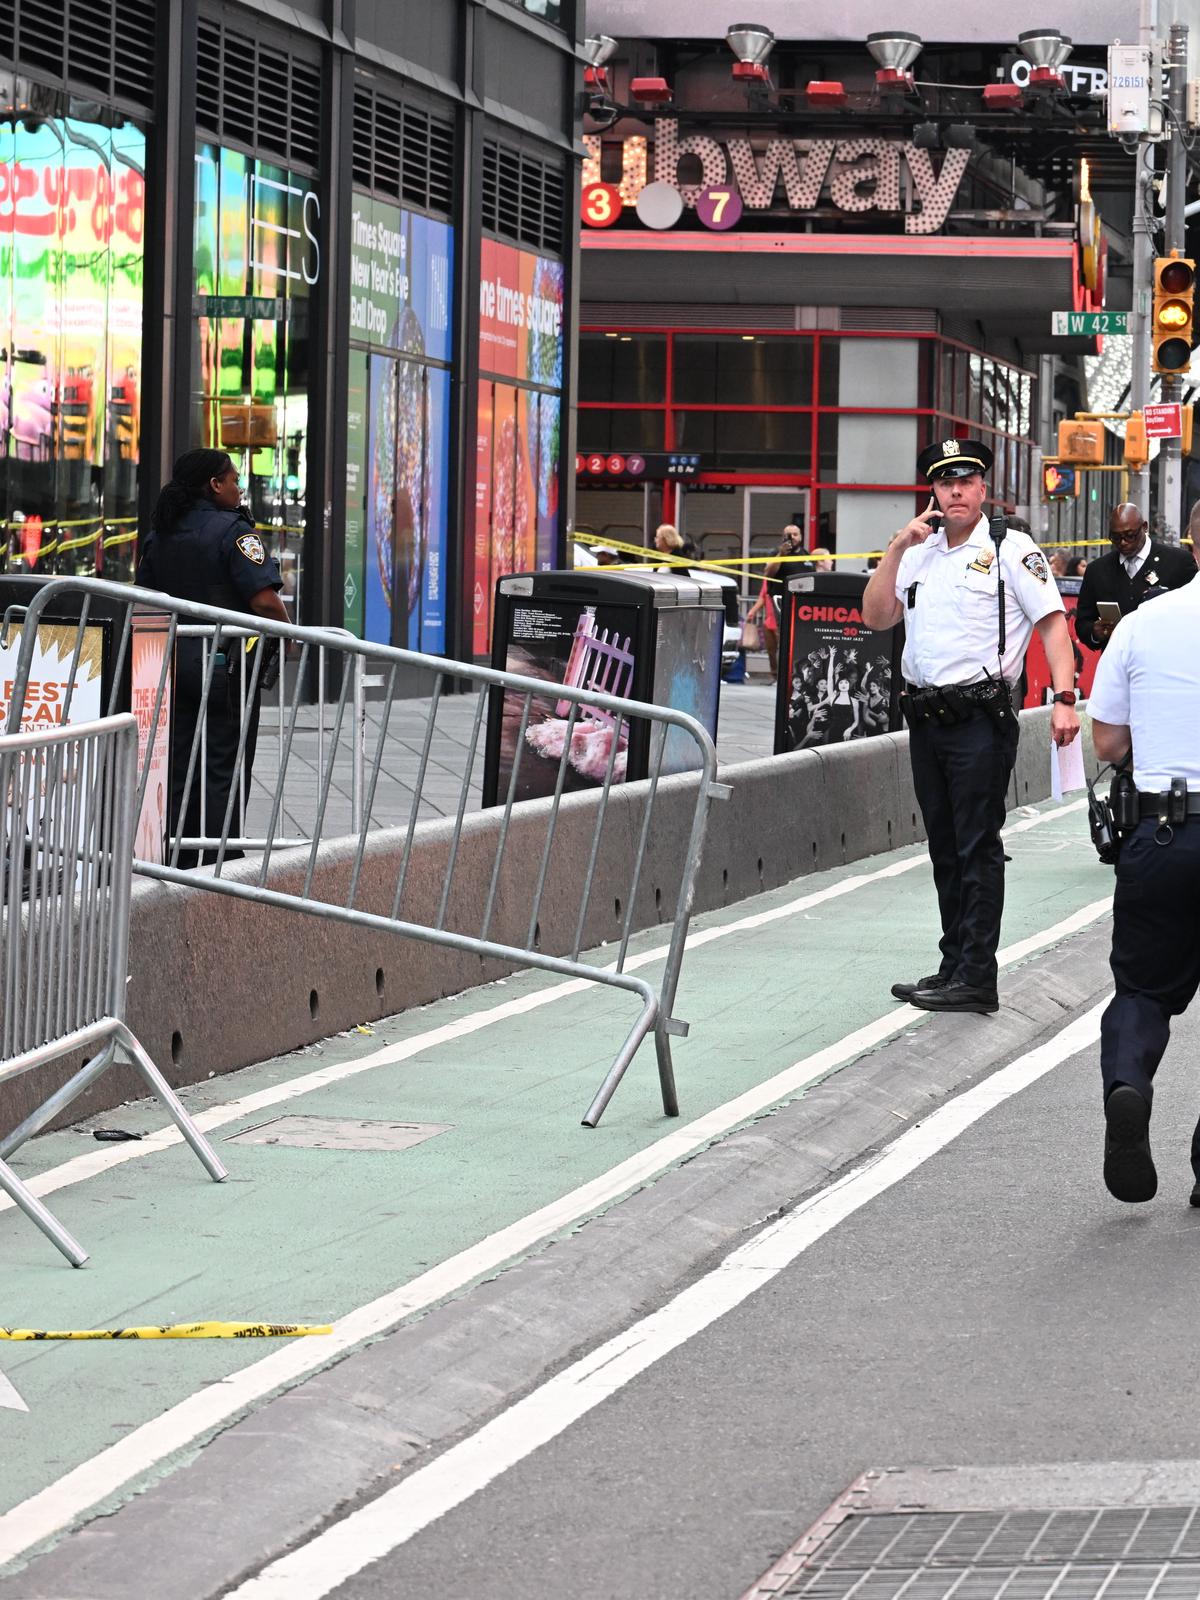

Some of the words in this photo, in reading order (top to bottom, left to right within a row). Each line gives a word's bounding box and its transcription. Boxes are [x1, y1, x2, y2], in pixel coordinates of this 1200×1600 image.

[1113, 76, 1144, 88] 726151
[582, 118, 972, 234] ubway
[587, 189, 611, 221] 3
[708, 192, 730, 223] 7
[352, 211, 377, 249] Times
[378, 222, 406, 264] Square
[351, 255, 370, 289] New
[371, 260, 395, 296] Year's
[395, 267, 409, 300] Eve
[480, 280, 495, 319] ne
[496, 277, 524, 327] times
[526, 293, 562, 340] square
[350, 295, 367, 328] Ball
[368, 300, 387, 344] Drop
[1071, 315, 1084, 333] W
[1092, 315, 1109, 332] 42
[1115, 314, 1126, 326] St
[1146, 408, 1152, 416] NO
[1153, 407, 1175, 415] STANDING
[1147, 416, 1165, 424] Anytime
[591, 459, 600, 470] 2
[611, 459, 621, 470] 3
[632, 459, 641, 470] 7
[798, 605, 863, 623] CHICA
[843, 627, 858, 637] 30
[135, 688, 149, 709] THE
